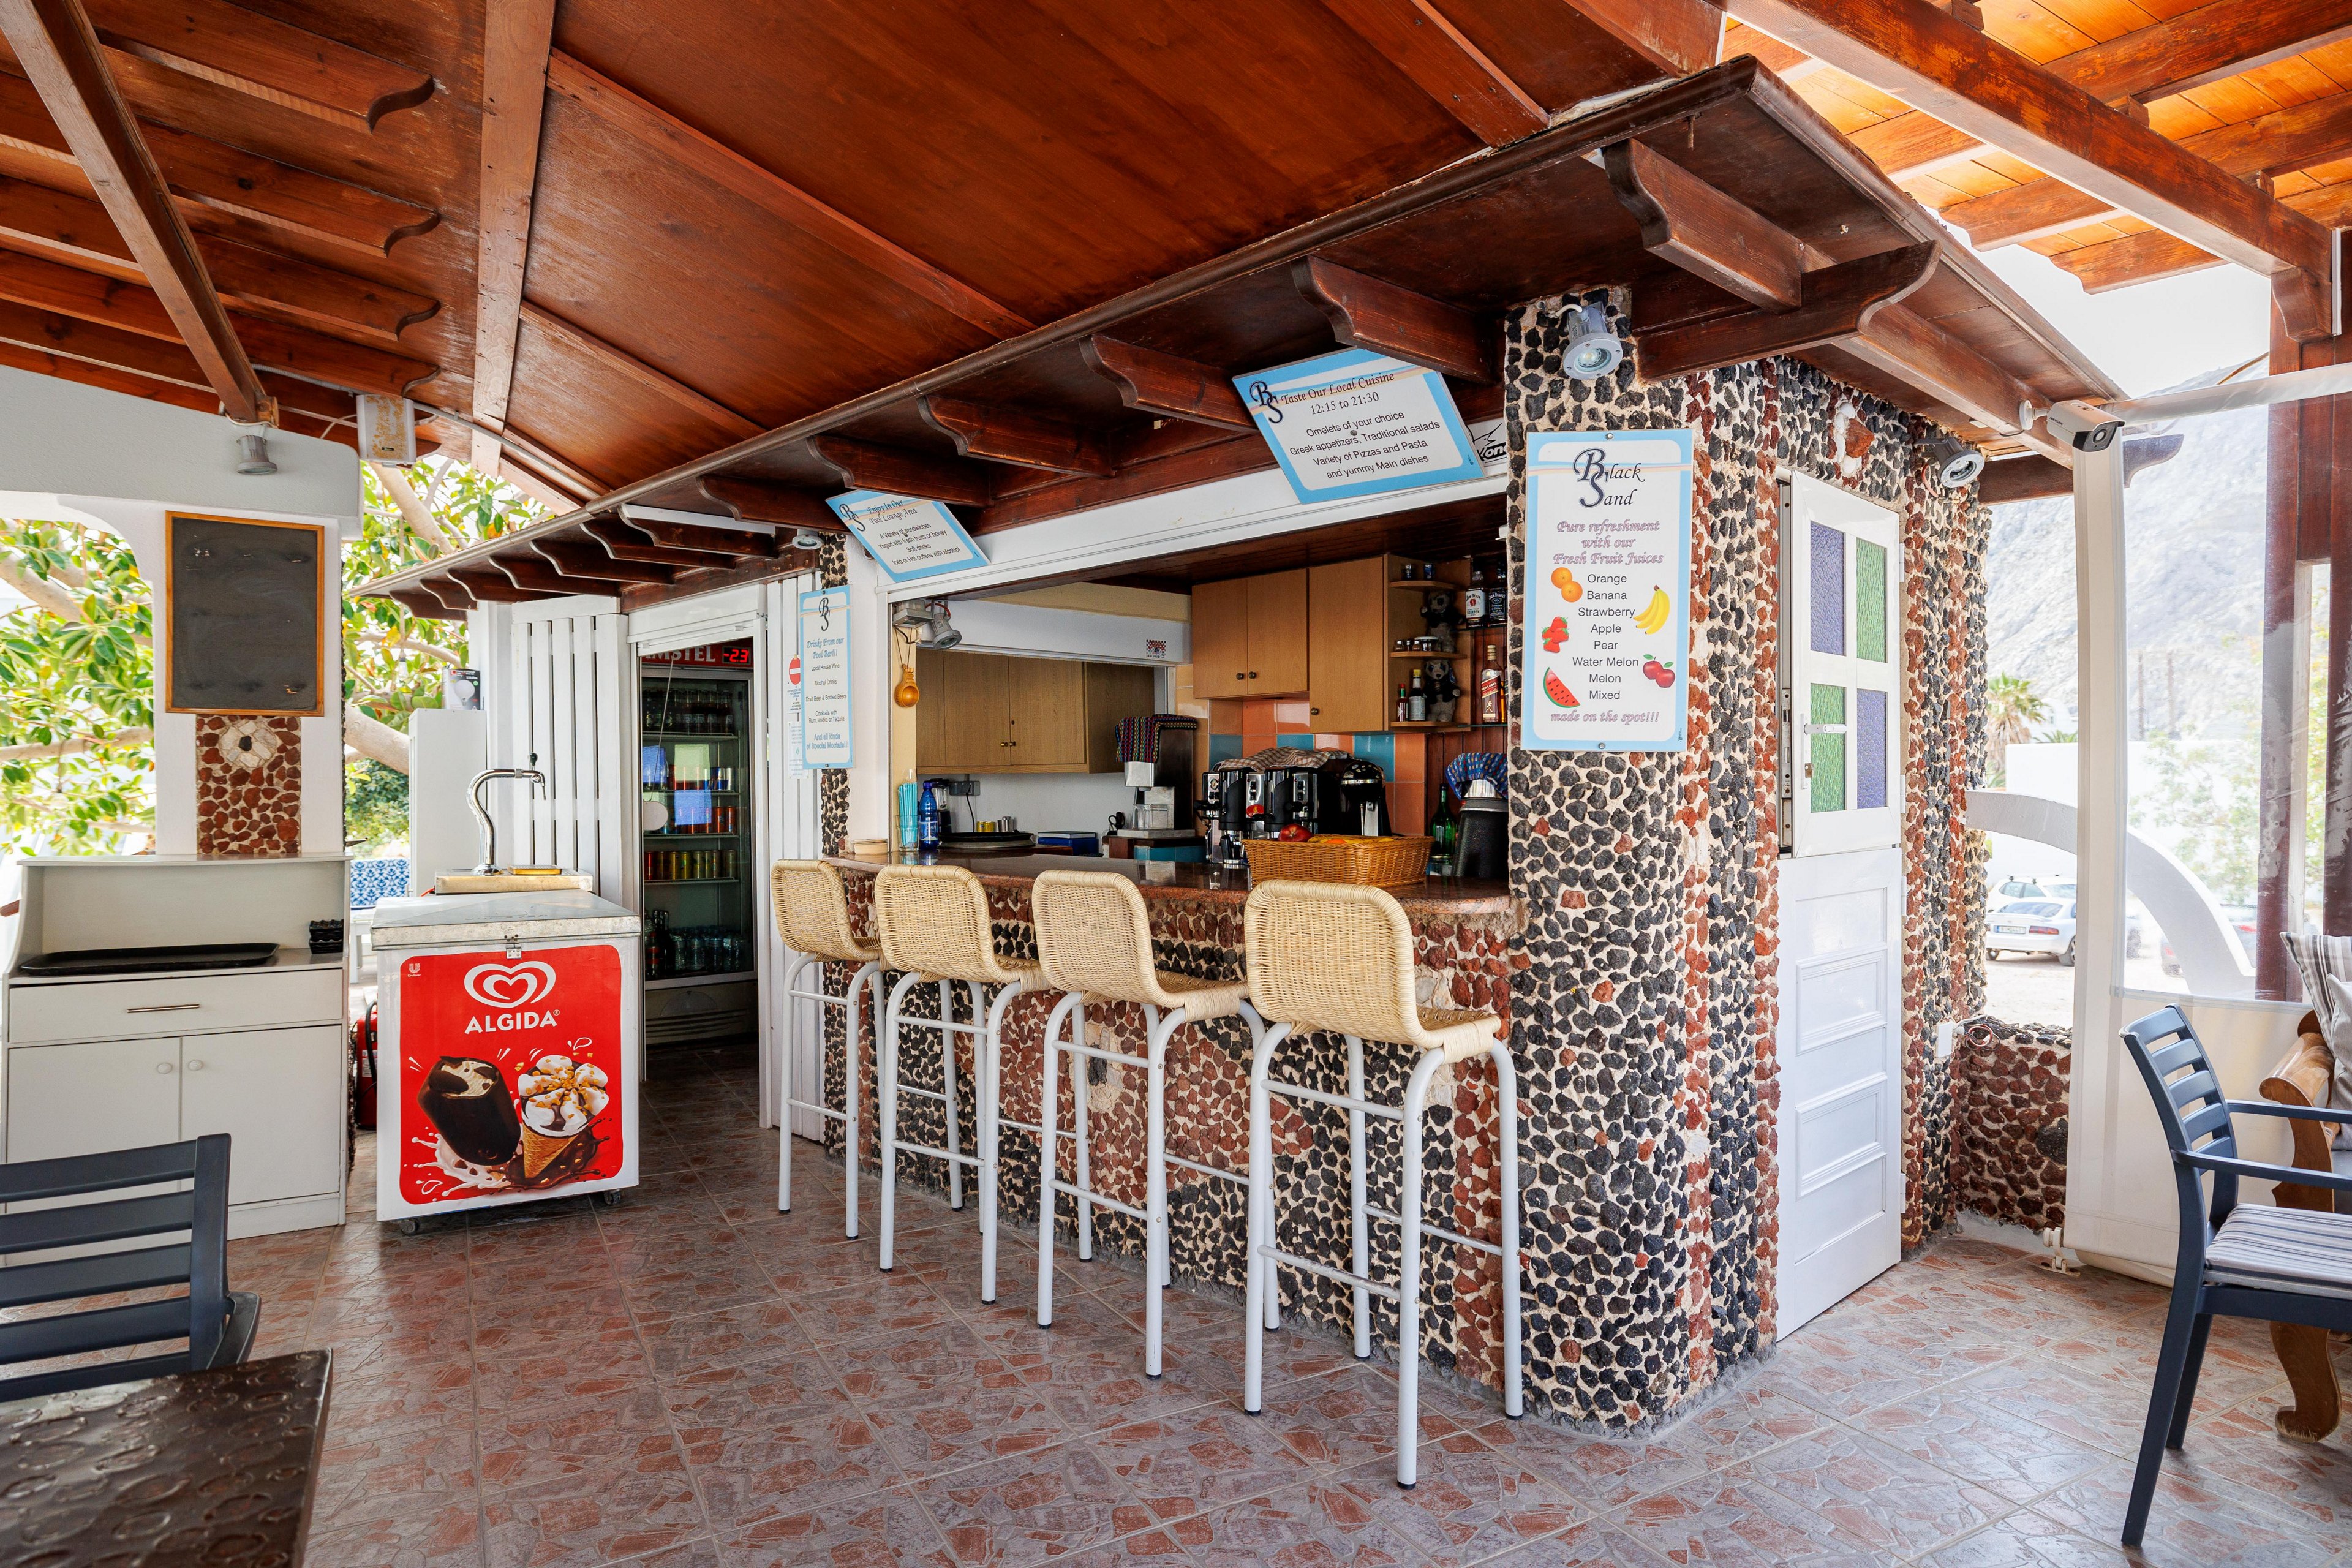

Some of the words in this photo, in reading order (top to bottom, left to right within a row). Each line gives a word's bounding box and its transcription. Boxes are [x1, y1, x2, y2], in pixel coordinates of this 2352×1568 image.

[1281, 393, 1306, 405] Taste
[1308, 388, 1326, 398] Our
[1330, 378, 1356, 394] Local
[1358, 373, 1395, 389] Cuisine
[1310, 401, 1336, 415] 12:15
[1340, 399, 1349, 409] to
[1351, 392, 1379, 407] 21:30
[1306, 424, 1341, 437] Omelets
[1343, 421, 1352, 430] of
[1353, 418, 1372, 430] your
[1375, 412, 1404, 424] choice
[1290, 444, 1314, 455] Greek
[1316, 436, 1362, 451] appetizers,
[1362, 426, 1409, 442] Traditional
[1410, 421, 1441, 432] salads
[1313, 454, 1342, 466] Variety
[1344, 452, 1352, 461] of
[1353, 447, 1381, 459] Pizzas
[1384, 444, 1400, 454] and
[1401, 440, 1428, 450] Pasta
[1327, 469, 1343, 478] and
[1344, 464, 1374, 477] yummy
[1376, 459, 1398, 470] Main
[1400, 455, 1429, 466] dishes
[1573, 448, 1645, 483] Black
[1579, 471, 1638, 508] Sand
[867, 505, 886, 516] Enjoy
[869, 514, 883, 524] Pool
[883, 512, 903, 521] Lounge
[903, 508, 918, 517] Area
[904, 523, 931, 533] sandwiches
[1557, 521, 1585, 533] Pure
[1589, 519, 1660, 536] refreshment
[1581, 535, 1611, 548] with
[1614, 538, 1636, 548] our
[943, 546, 961, 555] alcohol
[1553, 551, 1587, 564] Fresh
[1591, 552, 1623, 564] Fruit
[1625, 552, 1664, 566] Juices
[1588, 574, 1627, 585] Orange
[1588, 591, 1627, 600] Banana
[1578, 608, 1635, 619] Strawberry
[1591, 624, 1621, 635] Apple
[807, 639, 822, 649] Drinks
[1594, 641, 1618, 649] Pear
[645, 646, 716, 662] MSTEL
[813, 650, 824, 659] Pool
[824, 649, 838, 657] Bar!!!
[1572, 657, 1603, 666] Water
[1607, 657, 1638, 666] Melon
[1589, 674, 1621, 683] Melon
[1589, 691, 1620, 699] Mixed
[1551, 710, 1580, 722] made
[1583, 713, 1597, 722] on
[1600, 710, 1618, 722] the
[1621, 712, 1660, 725] spot!!!
[812, 742, 826, 751] Special
[464, 1010, 557, 1035] ALGIDA
